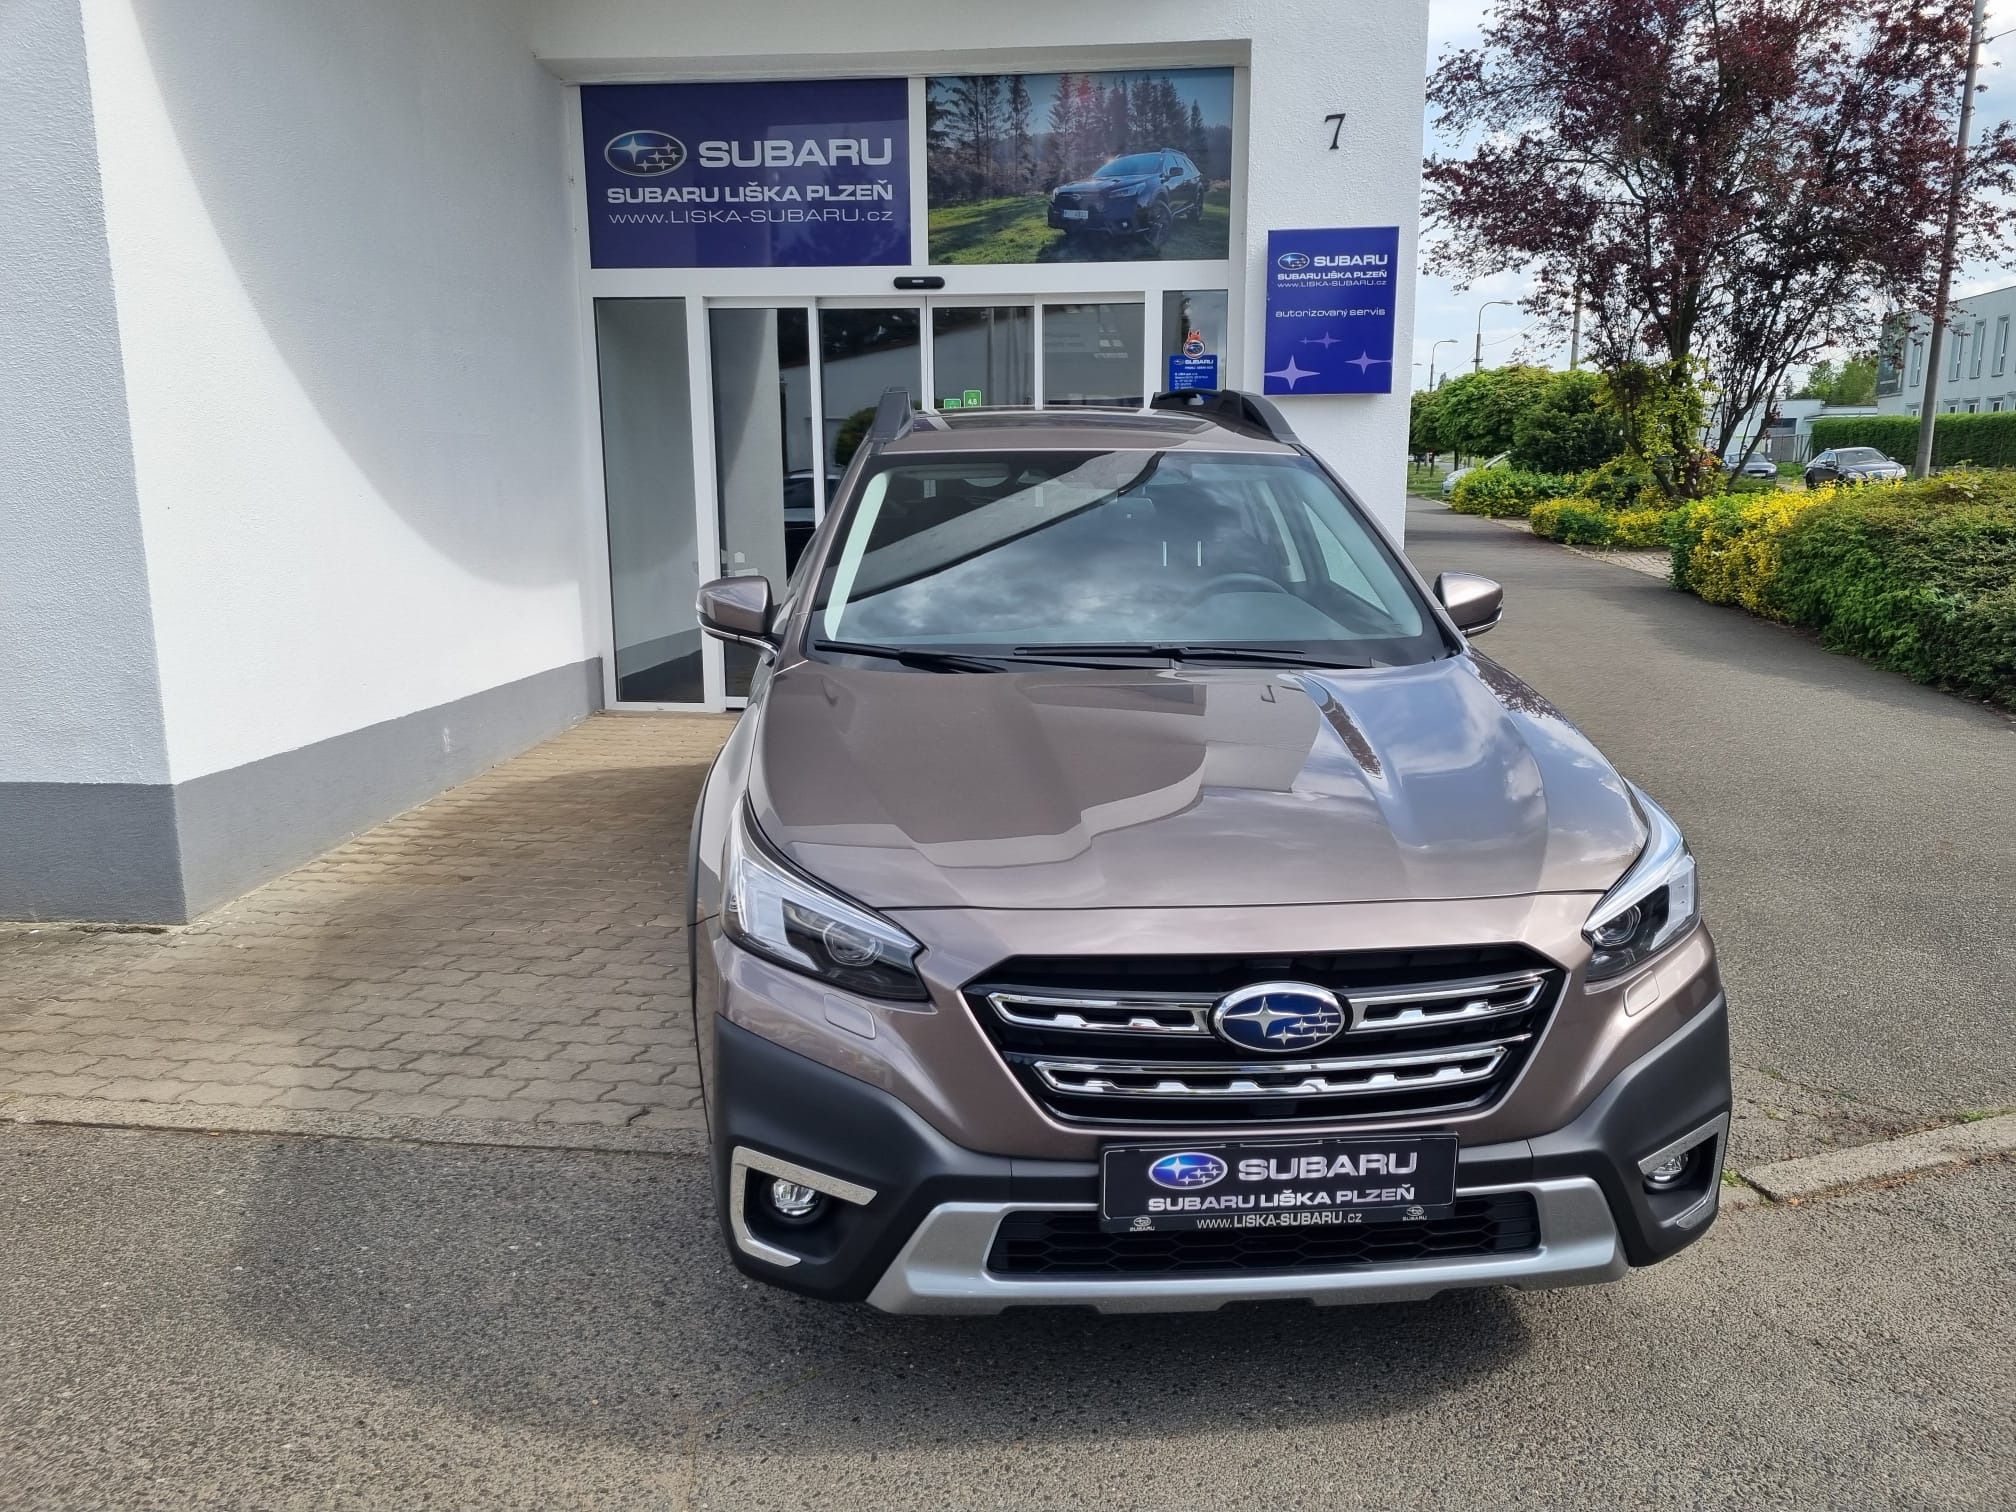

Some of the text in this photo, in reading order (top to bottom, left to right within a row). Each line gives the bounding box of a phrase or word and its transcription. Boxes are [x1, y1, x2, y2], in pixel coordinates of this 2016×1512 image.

[1324, 113, 1346, 150] 7
[698, 138, 892, 168] SUBARU
[607, 179, 893, 203] SUBARU LIŠKA PLZEŇ
[608, 208, 893, 223] www.LISKA-SUBARU.cz
[1314, 254, 1388, 267] SUBARU
[1277, 269, 1387, 280] SUBARU LIŠKA PLZEŇ
[1275, 306, 1386, 318] autorizovaný servis
[1238, 1151, 1418, 1182] SUBARU
[1148, 1184, 1415, 1212] SUBARU LIŠKA PLZEŇ
[1196, 1211, 1363, 1229] www.LISKA-SUBARU.cz
